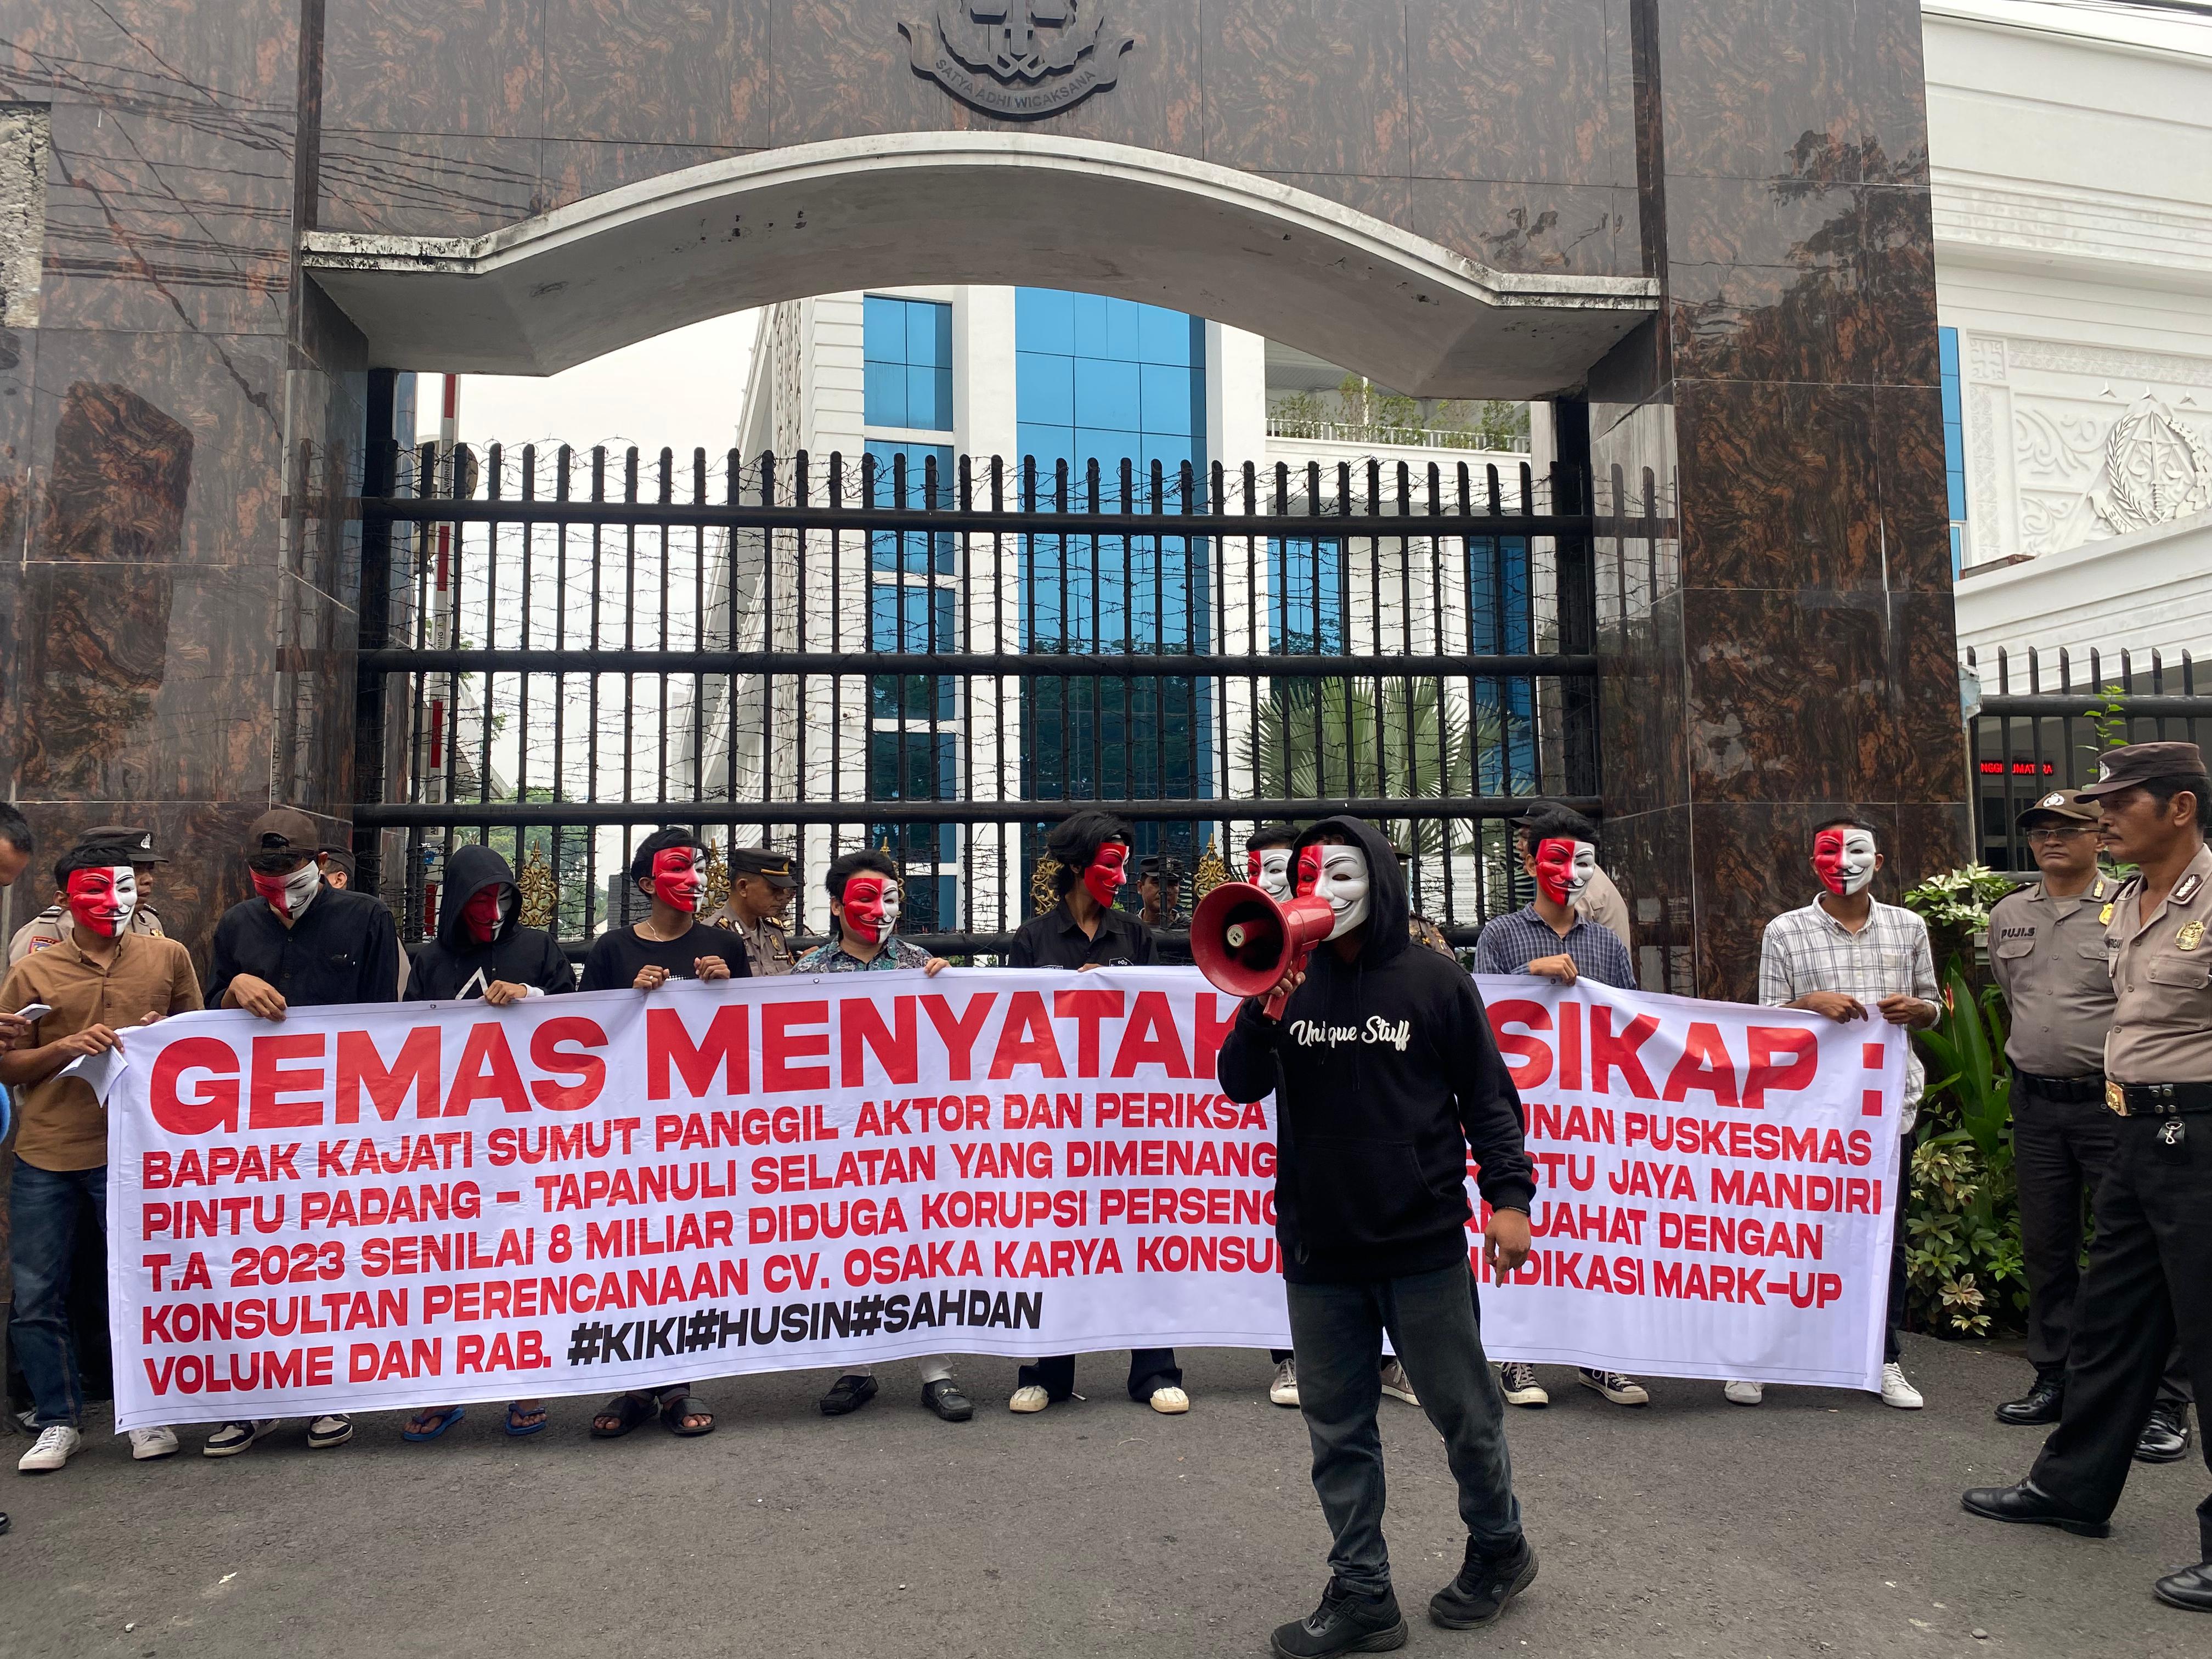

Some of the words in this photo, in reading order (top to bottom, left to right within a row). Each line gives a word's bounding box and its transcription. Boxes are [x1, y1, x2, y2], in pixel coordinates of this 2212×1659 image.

[935, 59, 973, 94] SATYA
[975, 88, 1011, 108] ADHI
[1014, 70, 1096, 109] WICAKSANA
[1980, 763, 2002, 774] NGGI
[2001, 927, 2035, 939] PUJI.S
[150, 1017, 608, 1135] GEMAS
[647, 990, 1244, 1100] MENYATAK
[1486, 1000, 1818, 1109] SIKAP
[1290, 1020, 1357, 1049] Unique
[1361, 1015, 1410, 1052] Stuff
[143, 1143, 301, 1189] BAPAK
[318, 1132, 472, 1178] KAJATI
[488, 1117, 640, 1166] SUMUT
[656, 1105, 838, 1152] PANGGIL
[855, 1095, 990, 1137] AKTOR
[1003, 1093, 1082, 1129] DAN
[1096, 1093, 1267, 1130] PERIKSA
[1625, 1112, 1871, 1166] PUSKESMAS
[143, 1194, 284, 1239] PINTU
[301, 1181, 480, 1229] PADANG
[535, 1160, 736, 1212] TAPANULI
[752, 1146, 935, 1194] SELATAN
[951, 1141, 1052, 1178] YANG
[1067, 1141, 1277, 1178] DIMENANG
[1609, 1159, 1696, 1201] JAYA
[1712, 1168, 1881, 1214] MANDIRI
[143, 1252, 212, 1291] T.A
[231, 1241, 345, 1287] 2023
[362, 1228, 534, 1277] SENILAI
[549, 1224, 572, 1263] 8
[586, 1210, 733, 1260] MILIAR
[749, 1197, 907, 1244] DIDUGA
[922, 1190, 1087, 1229] KORUPSI
[1527, 1201, 1646, 1245] JAHAT
[1660, 1212, 1822, 1260] DENGAN
[143, 1288, 408, 1344] KONSULTAN
[424, 1259, 748, 1324] PERENCANAAN
[764, 1252, 829, 1293] CV.
[844, 1240, 983, 1286] OSAKA
[995, 1238, 1122, 1278] KARYA
[1654, 1261, 1842, 1308] MARK-UP
[144, 1346, 333, 1395] VOLUME
[349, 1338, 442, 1383] DAN
[456, 1330, 551, 1374] RAB.
[568, 1290, 1042, 1365] #KIKI#HUSIN#SAHDAN
